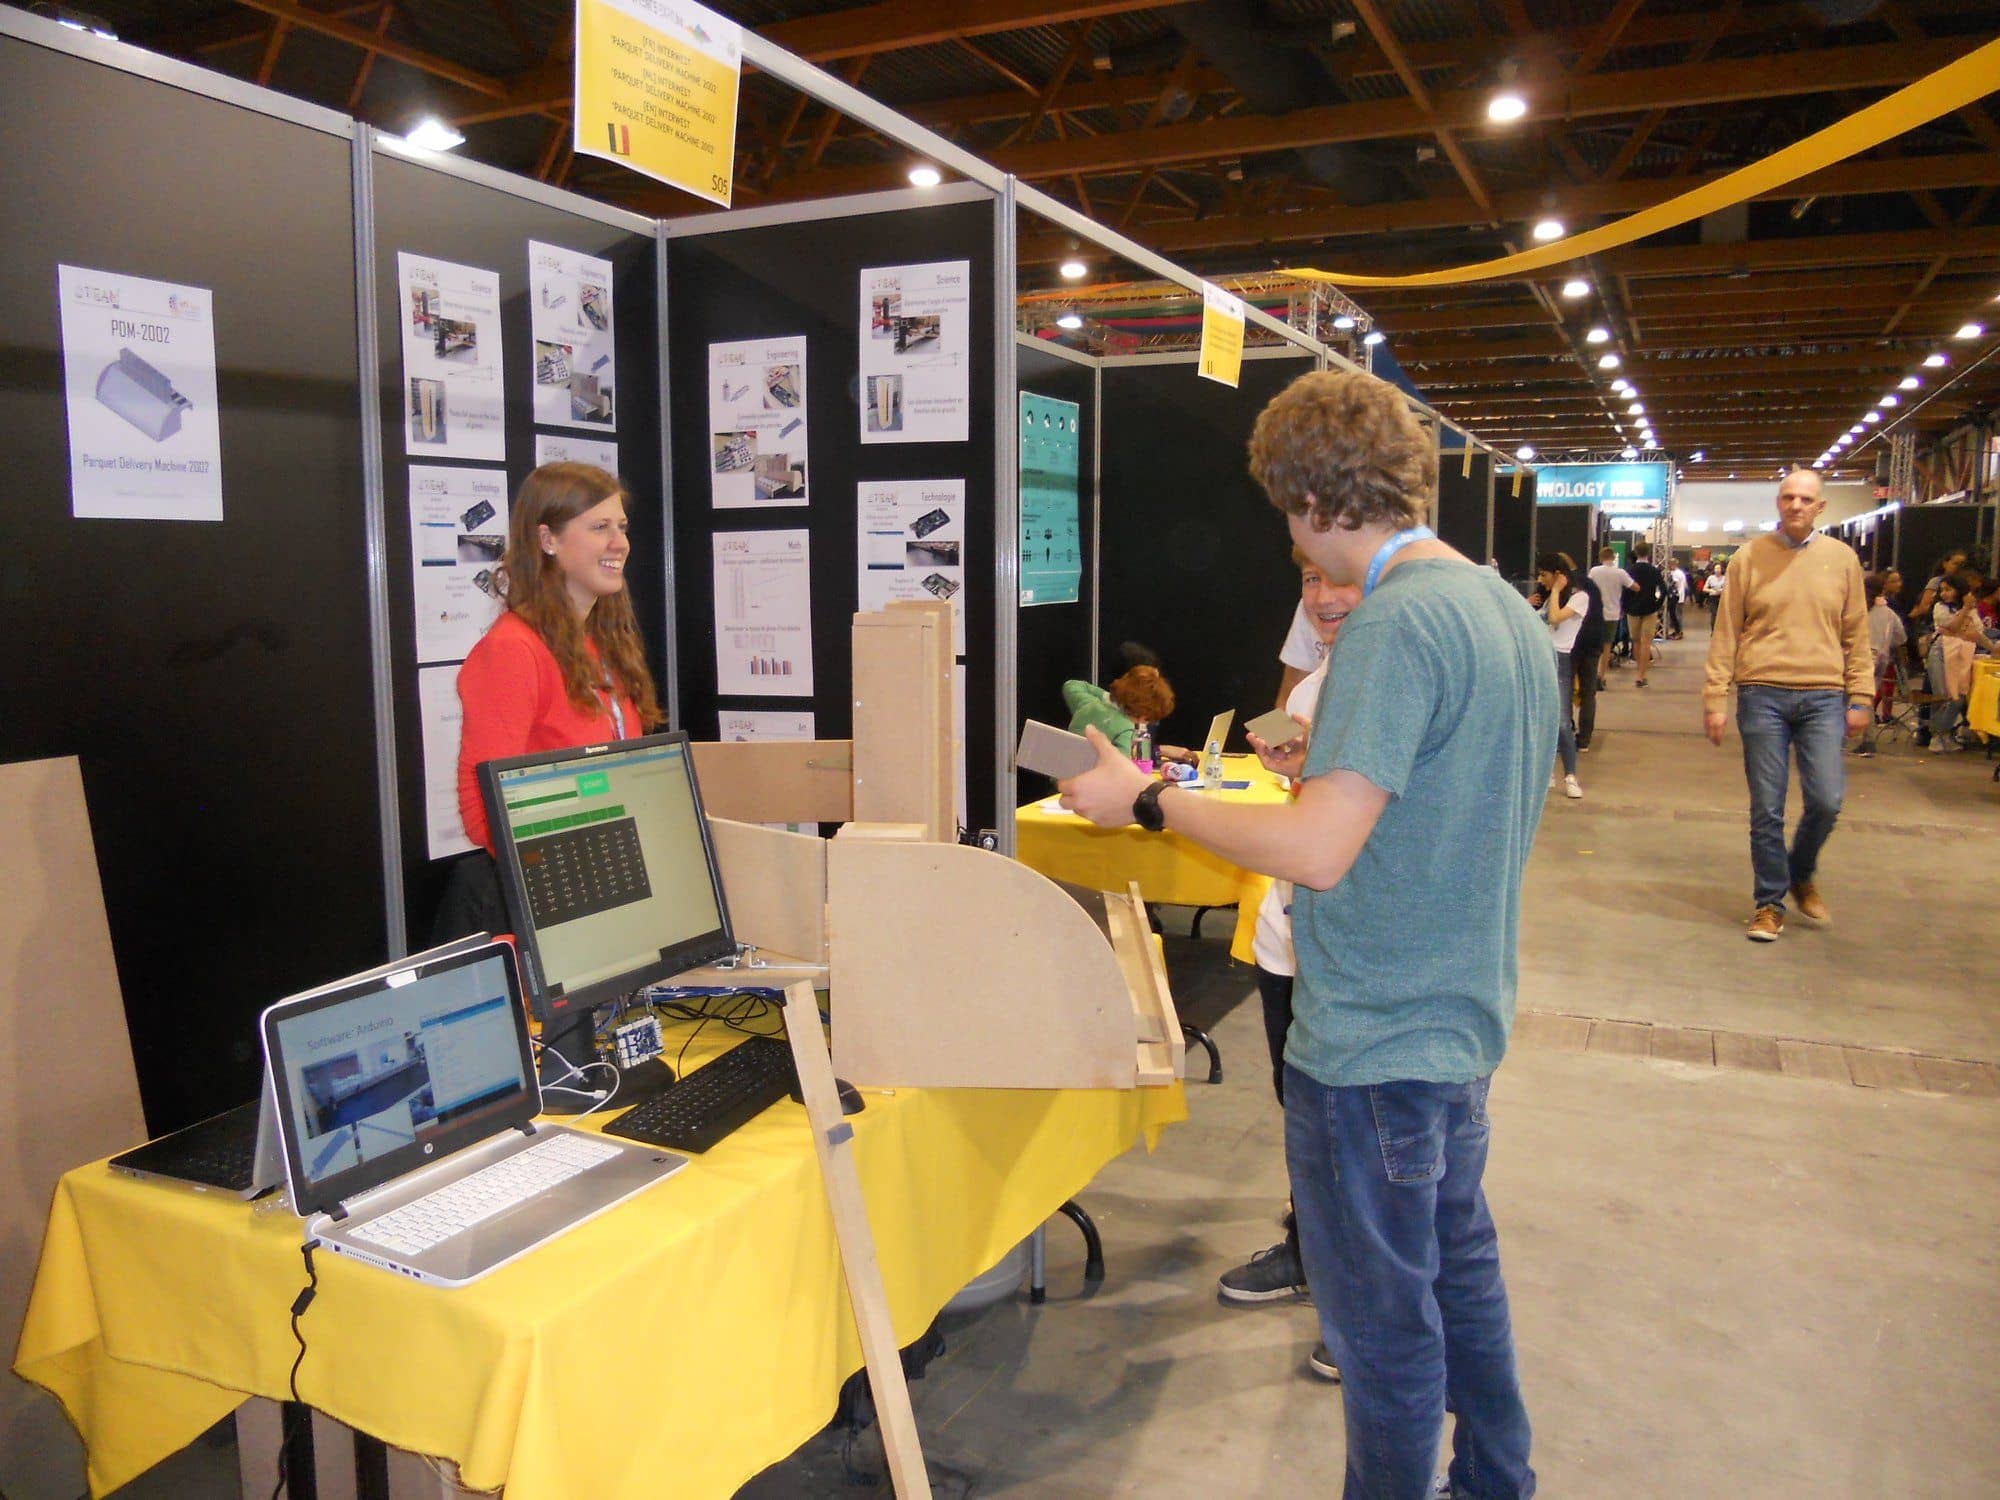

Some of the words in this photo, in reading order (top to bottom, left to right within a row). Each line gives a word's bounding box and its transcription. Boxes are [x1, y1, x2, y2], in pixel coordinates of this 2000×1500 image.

[111, 319, 171, 344] PDM-2002
[82, 454, 118, 471] Parquet
[119, 456, 153, 474] Delivery
[154, 458, 188, 474] Machine
